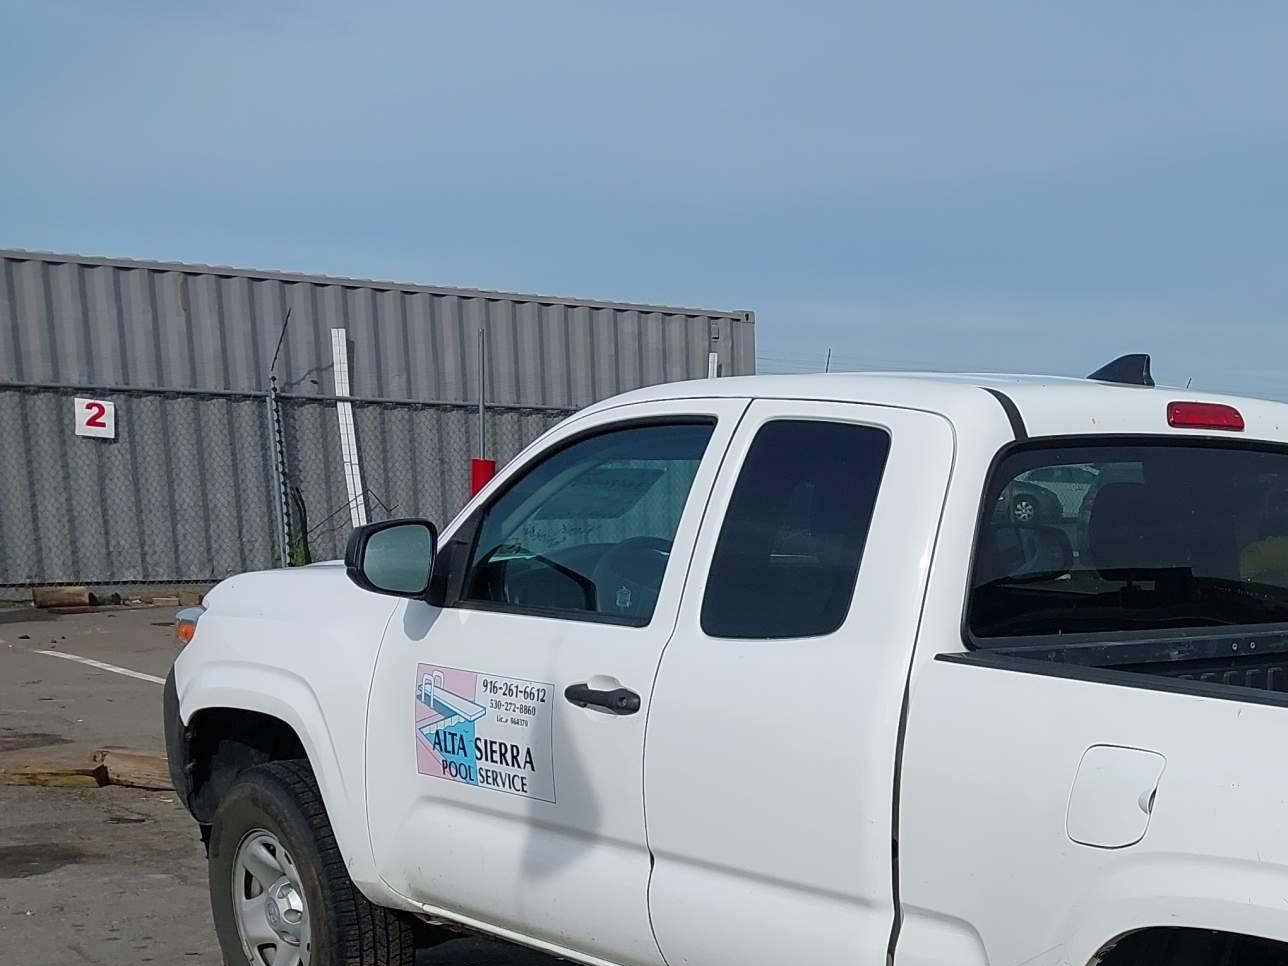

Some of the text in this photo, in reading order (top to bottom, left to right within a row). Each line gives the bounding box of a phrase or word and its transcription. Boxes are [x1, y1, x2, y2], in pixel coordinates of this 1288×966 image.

[85, 402, 106, 428] 2
[482, 679, 546, 703] 916-261-6612
[490, 699, 536, 716] 530-272-8860
[433, 729, 536, 772] ALTA SIERRA
[442, 760, 528, 793] POOL SERVICE
